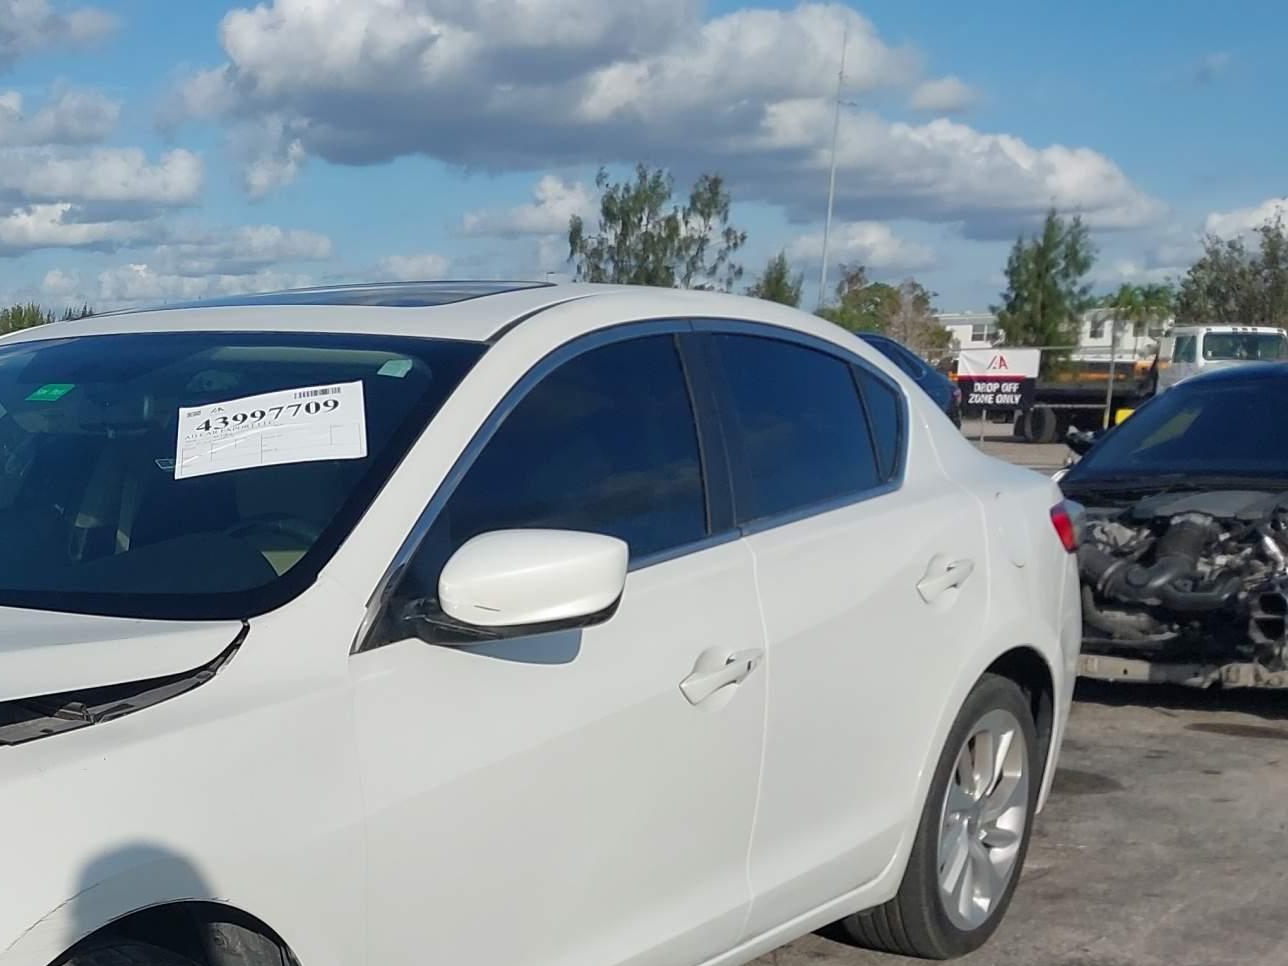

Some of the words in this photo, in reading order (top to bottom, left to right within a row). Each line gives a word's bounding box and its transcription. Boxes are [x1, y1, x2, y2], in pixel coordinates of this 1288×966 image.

[973, 382, 1000, 393] DROP
[1001, 382, 1021, 393] OFF
[967, 393, 994, 405] ZONE
[995, 393, 1022, 405] ONLY
[195, 399, 340, 432] 43997709
